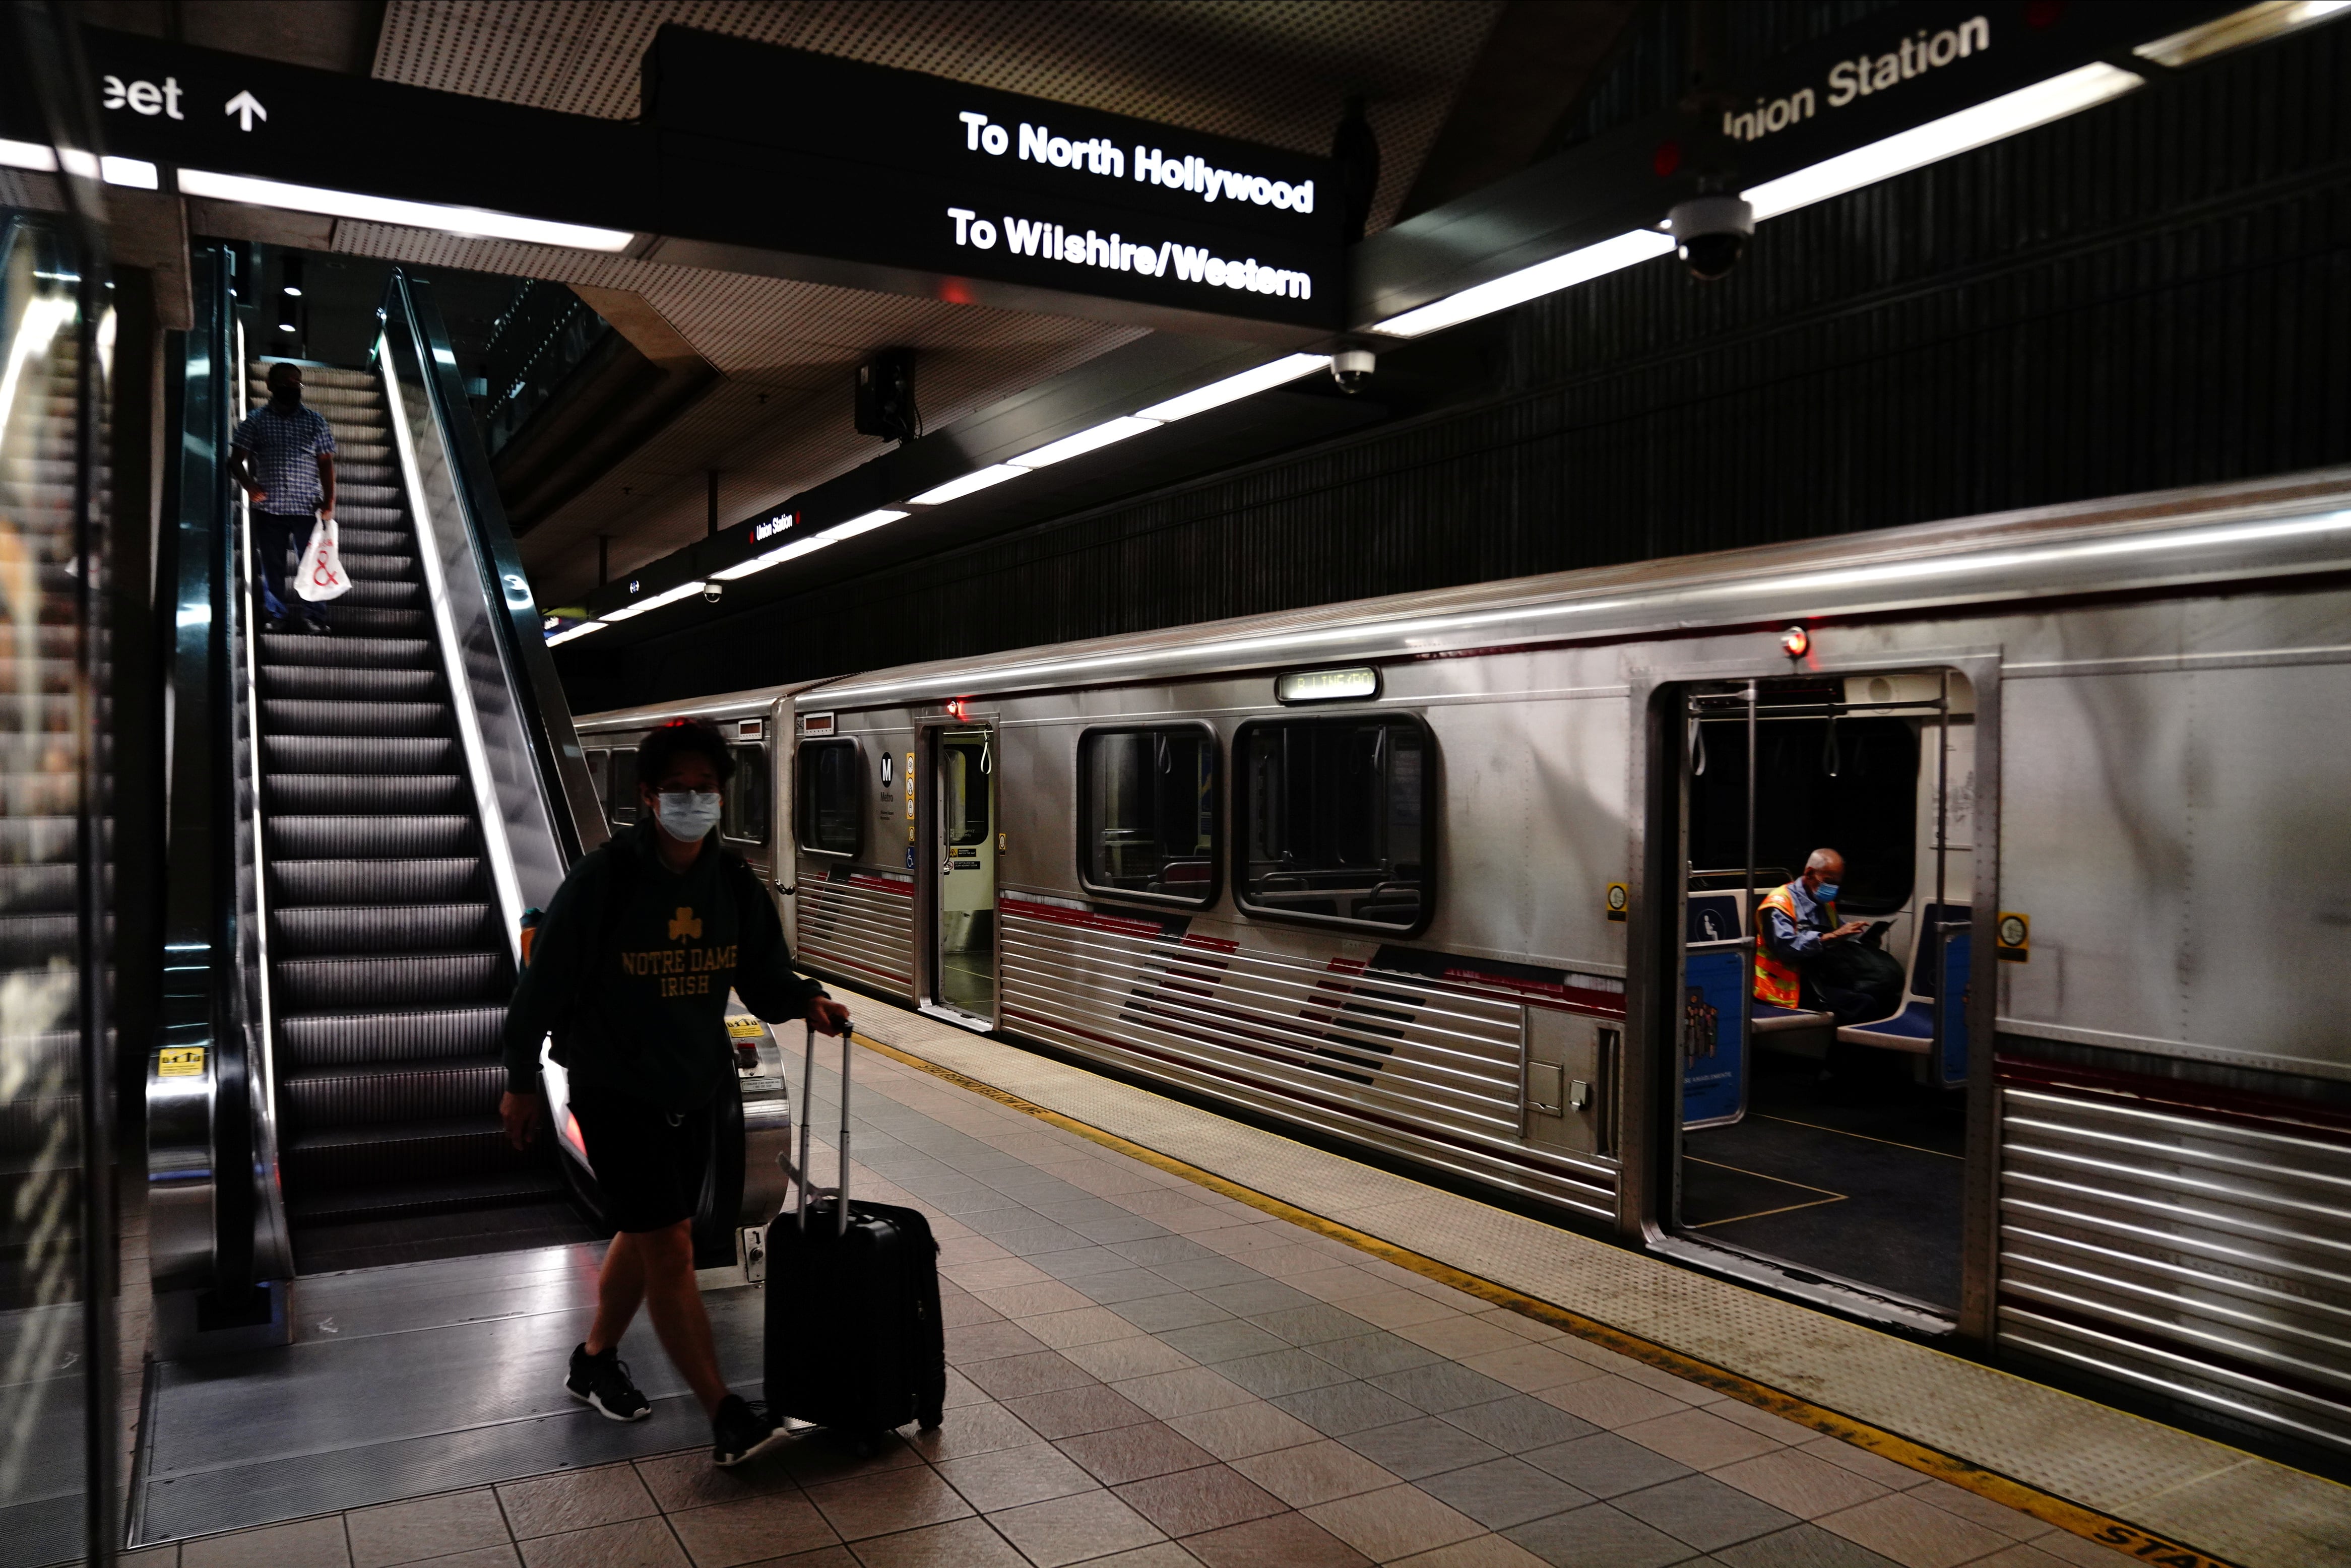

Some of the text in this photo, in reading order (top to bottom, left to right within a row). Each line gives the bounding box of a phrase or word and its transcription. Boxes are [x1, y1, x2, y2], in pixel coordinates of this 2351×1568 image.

[1826, 14, 1990, 107] Station
[959, 112, 1313, 213] To North Hollywood
[947, 208, 1310, 299] To Wilshire/Western
[756, 513, 793, 541] Union Station
[882, 758, 892, 781] M
[880, 792, 894, 803] Metro
[621, 944, 738, 975] NOTRE DAME
[660, 975, 710, 998] IRISH
